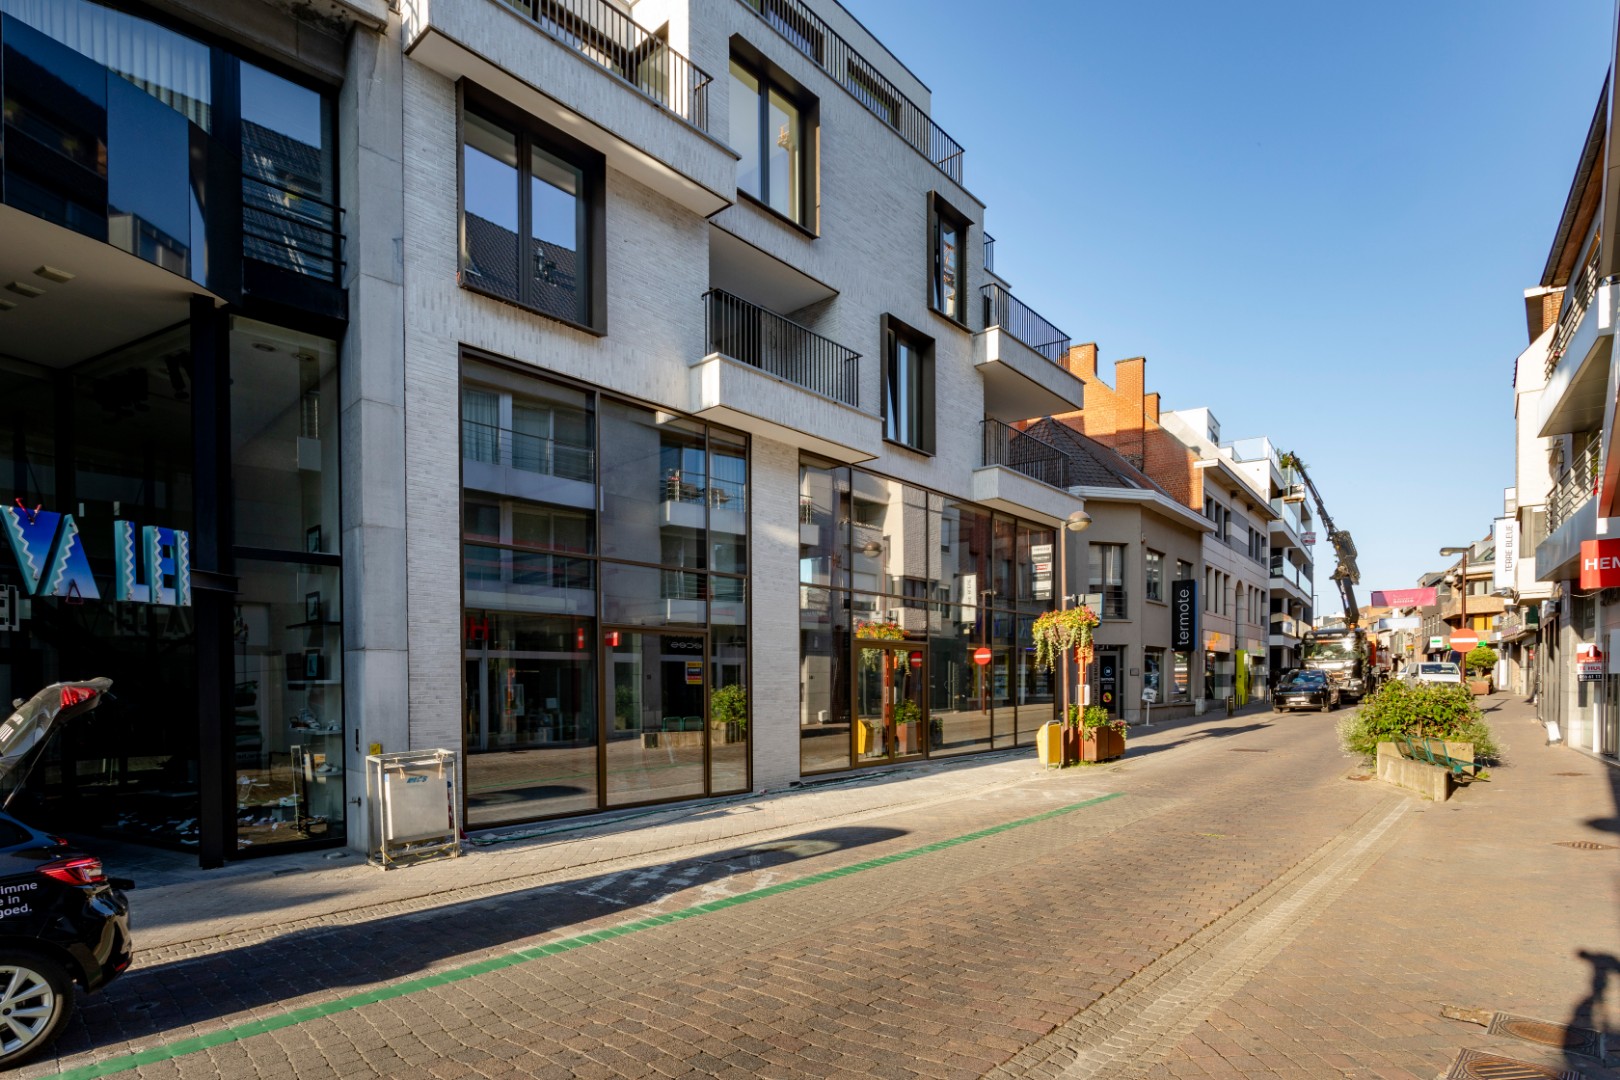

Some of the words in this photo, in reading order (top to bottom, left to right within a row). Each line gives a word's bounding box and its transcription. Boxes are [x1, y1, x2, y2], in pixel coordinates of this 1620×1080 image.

[1505, 525, 1514, 547] BLEUE
[1505, 549, 1513, 572] TERRE
[7, 895, 20, 905] in
